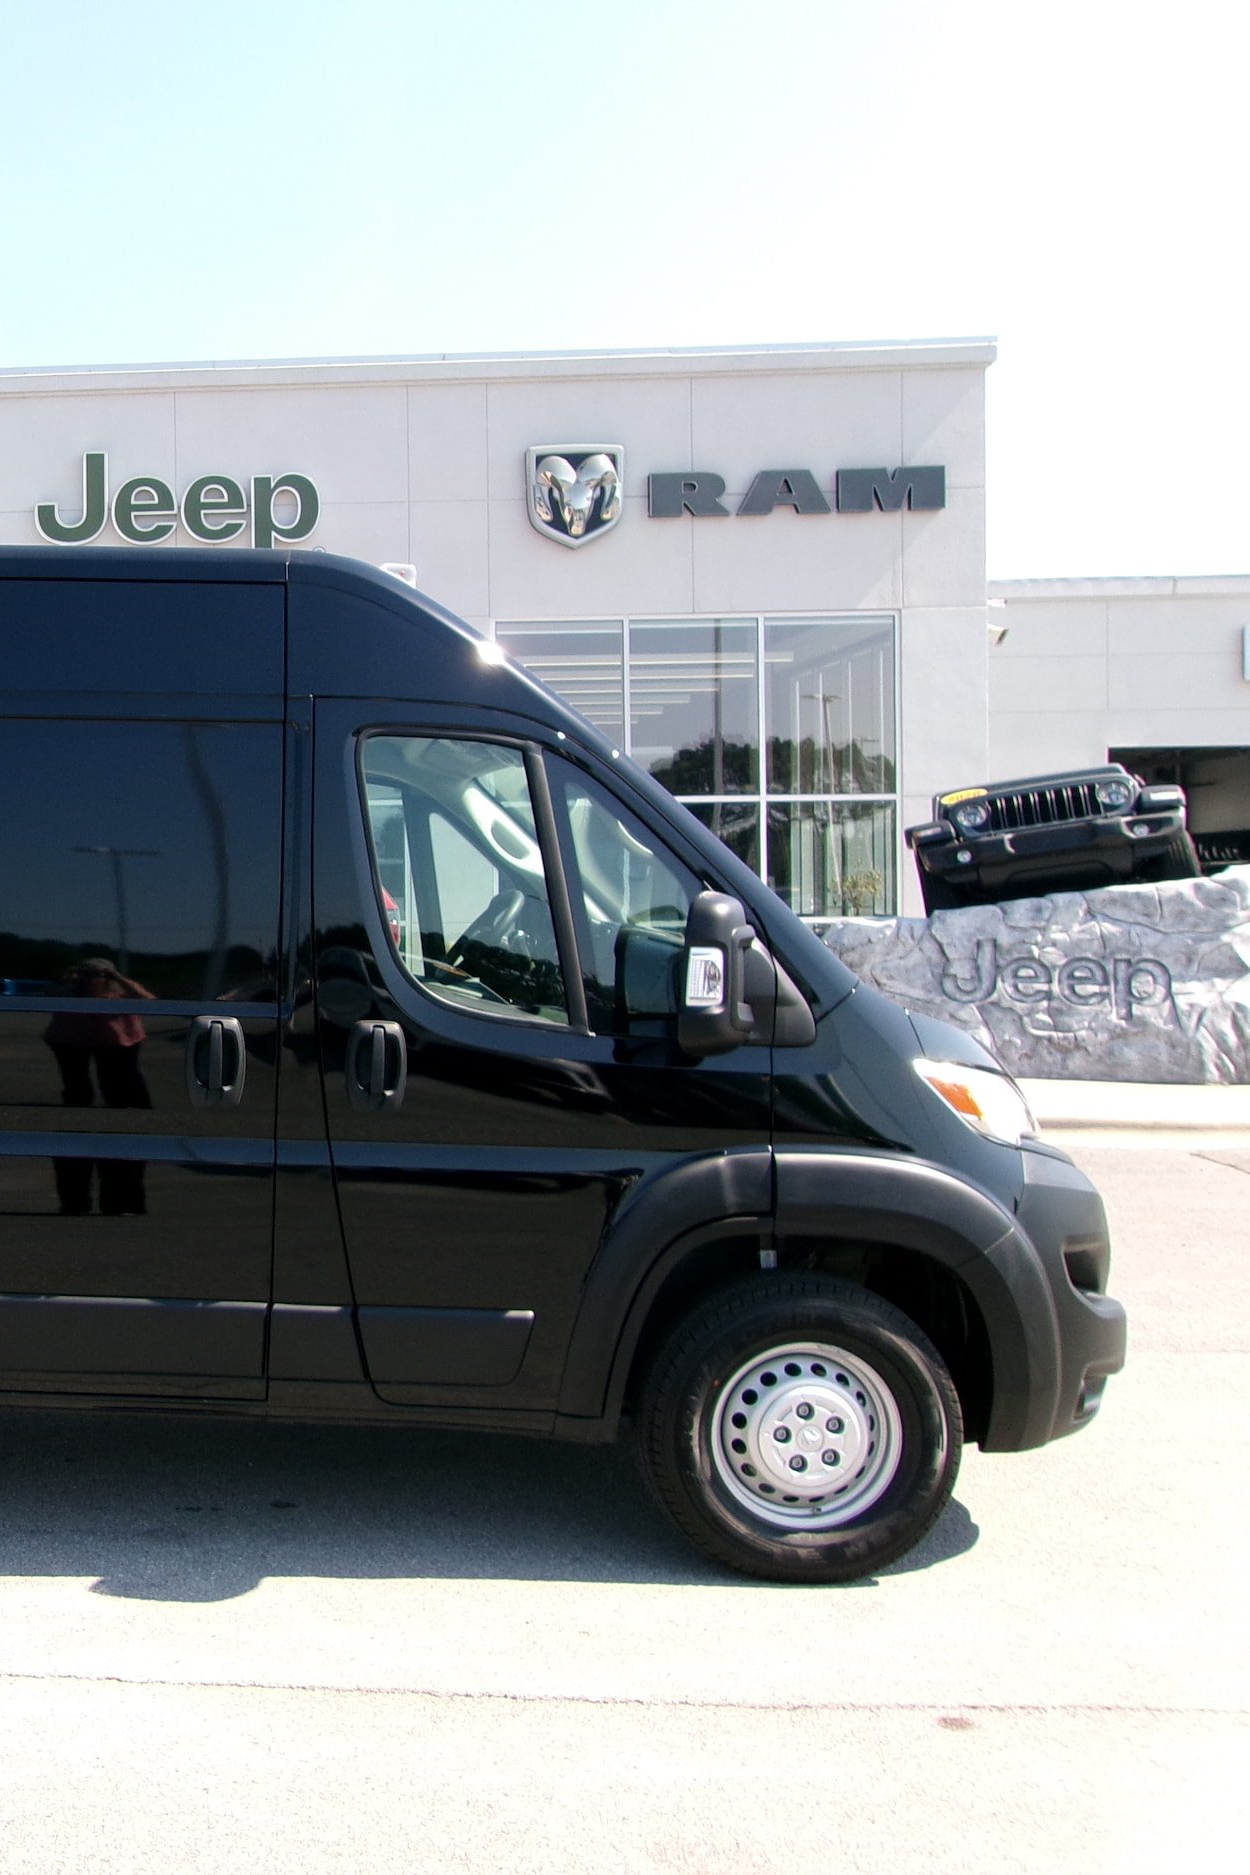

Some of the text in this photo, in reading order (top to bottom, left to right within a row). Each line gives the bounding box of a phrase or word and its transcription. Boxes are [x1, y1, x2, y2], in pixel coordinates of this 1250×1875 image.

[34, 451, 320, 549] Jeep
[647, 465, 946, 517] RAM
[941, 938, 1172, 1021] Jeep
